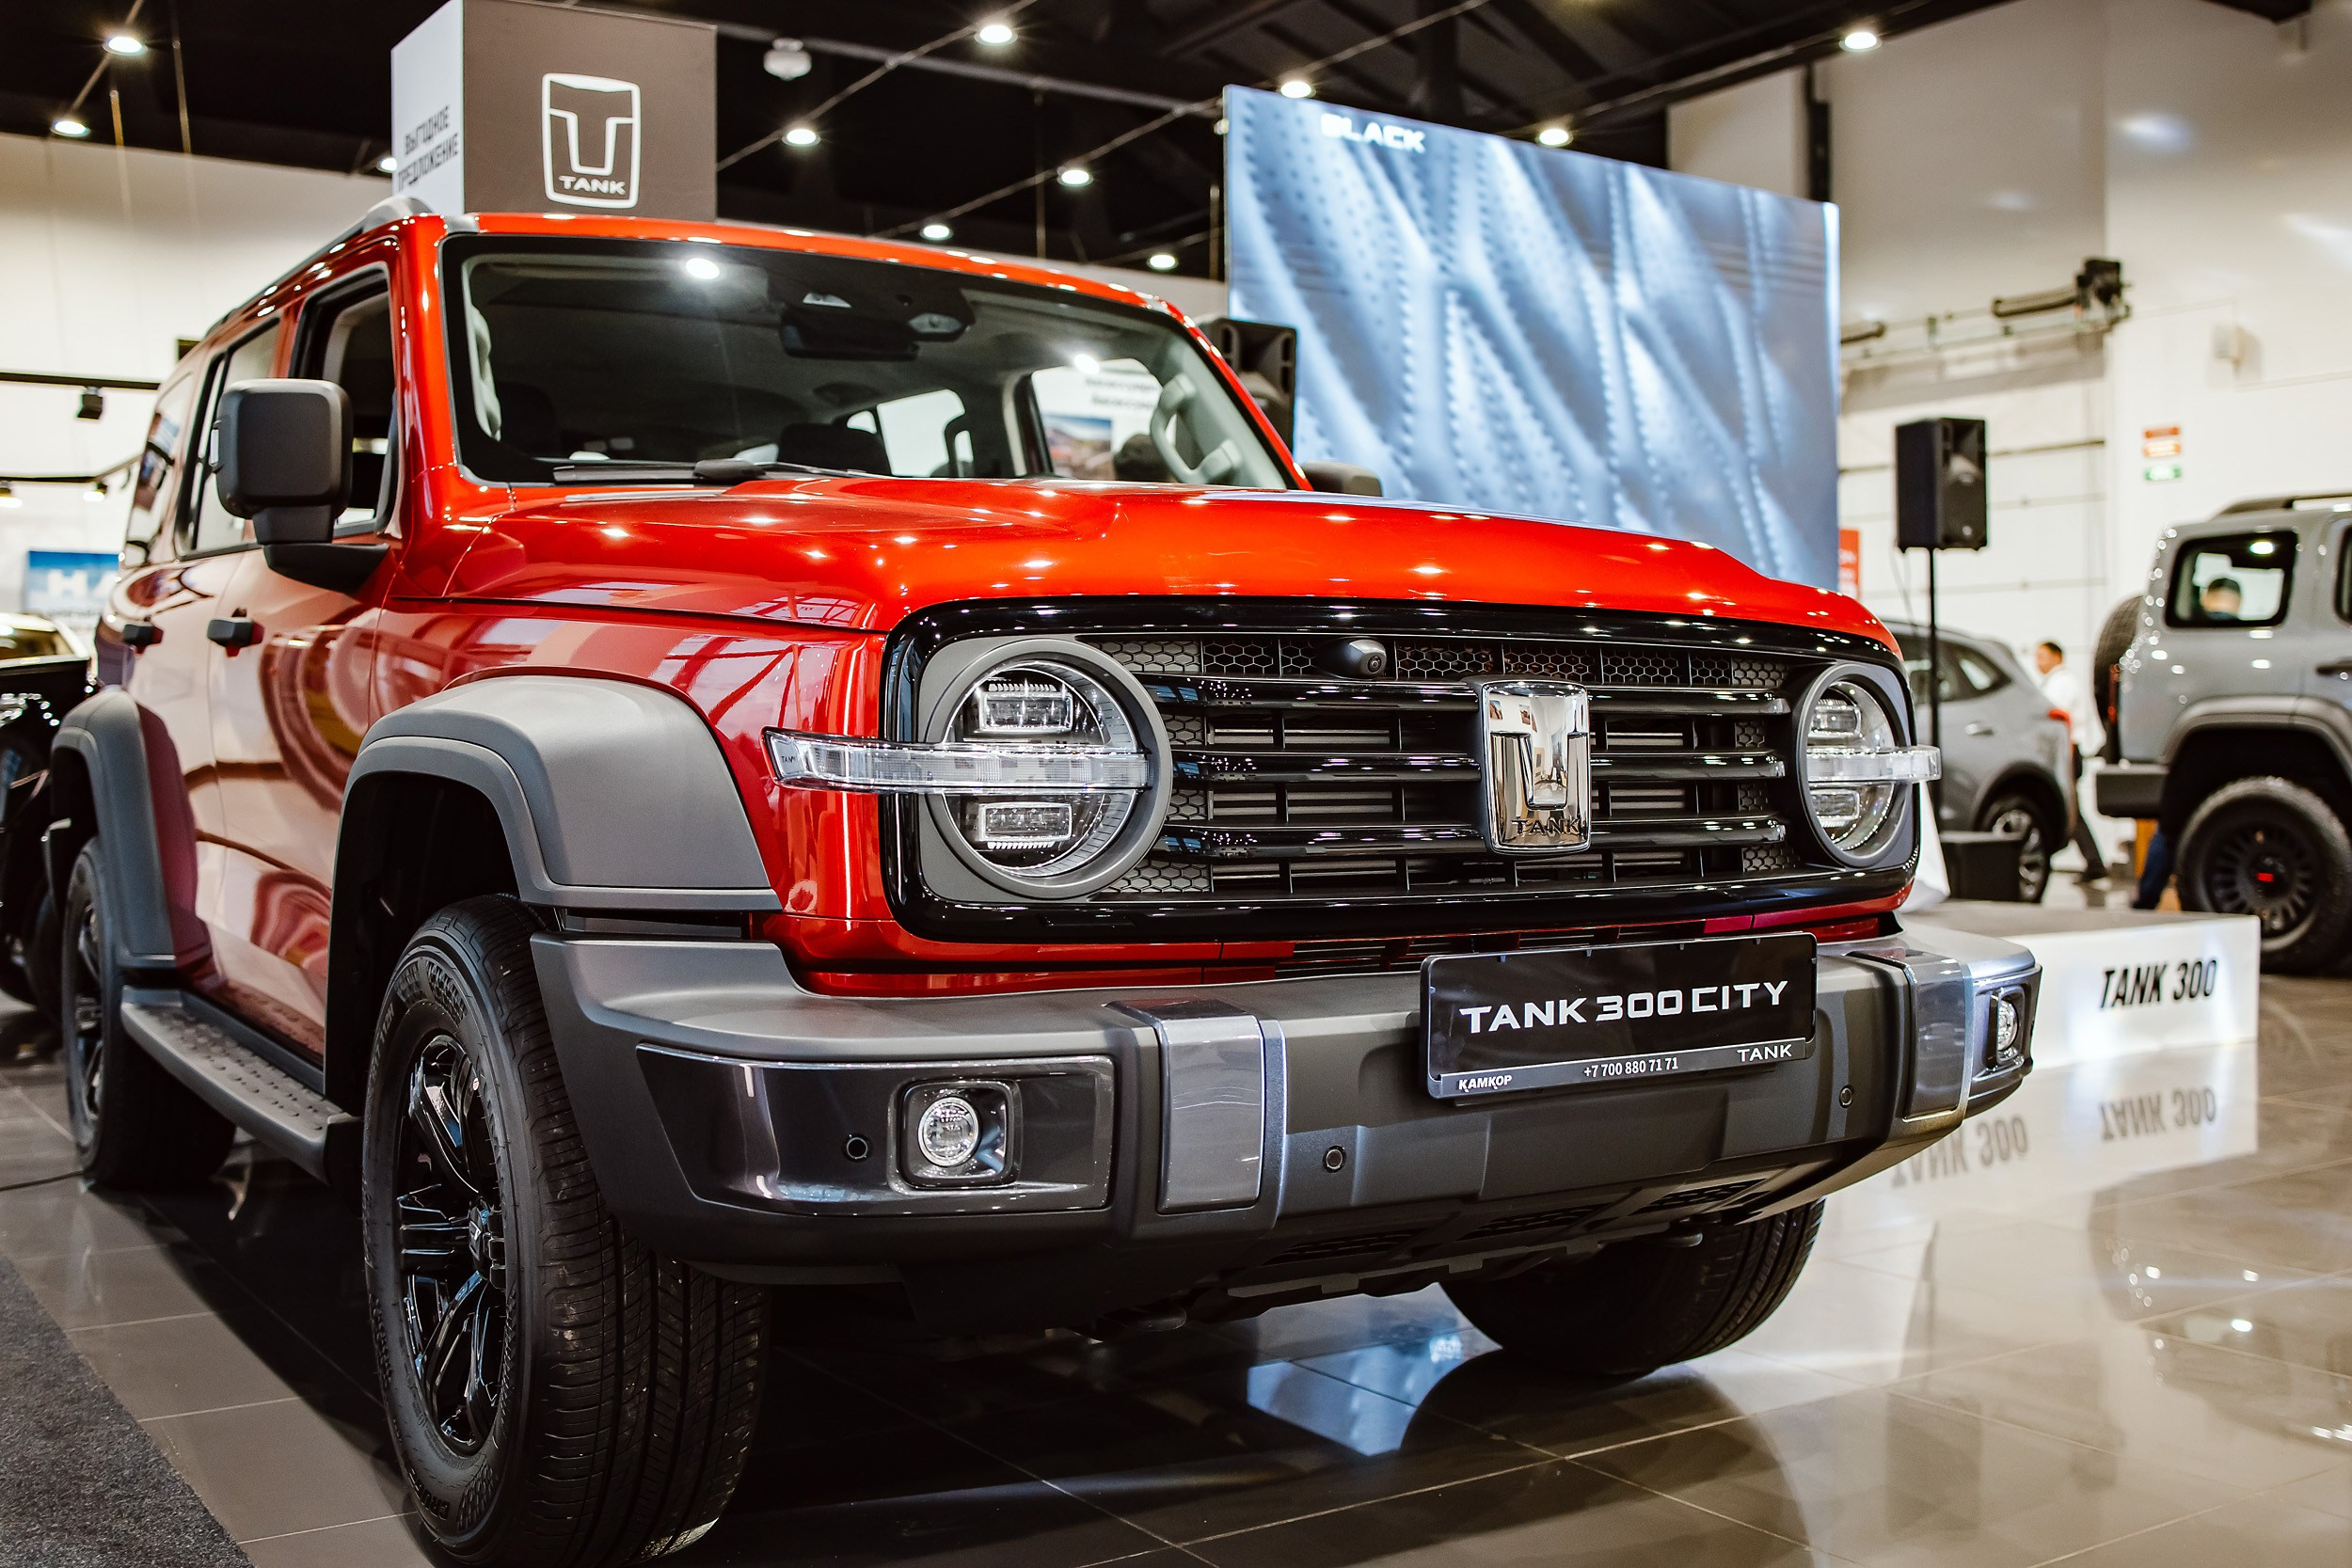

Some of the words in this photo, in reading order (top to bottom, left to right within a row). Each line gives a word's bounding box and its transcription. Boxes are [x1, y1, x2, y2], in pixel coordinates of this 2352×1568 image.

[1321, 113, 1426, 154] BLACK
[558, 175, 627, 196] TANK
[1511, 815, 1581, 837] TANK
[2101, 964, 2168, 1008] TANK
[2173, 959, 2217, 1000] 300
[1459, 997, 1587, 1034] TANK
[1595, 989, 1682, 1022] 300
[1692, 980, 1788, 1013] CITY
[1737, 1044, 1792, 1063] TANK
[1583, 1065, 1598, 1078] +7
[1600, 1062, 1623, 1077] 700
[1625, 1060, 1646, 1074] 880
[1648, 1058, 1662, 1072] 71
[1664, 1056, 1678, 1070] 71
